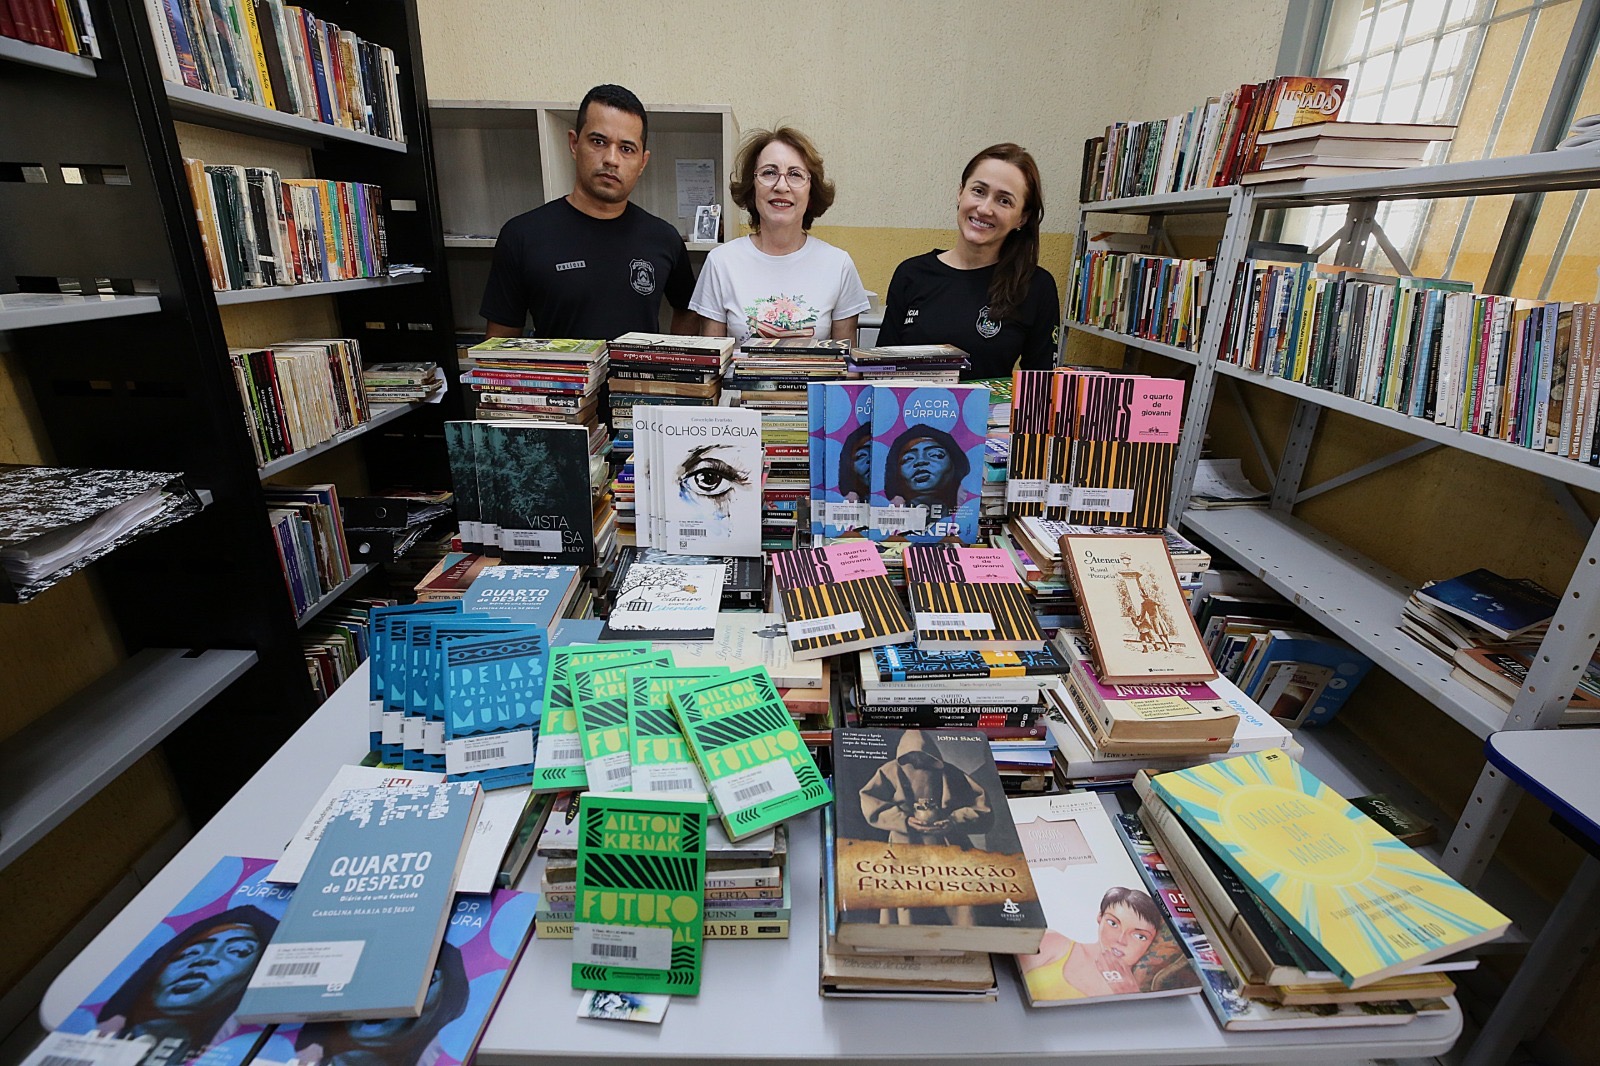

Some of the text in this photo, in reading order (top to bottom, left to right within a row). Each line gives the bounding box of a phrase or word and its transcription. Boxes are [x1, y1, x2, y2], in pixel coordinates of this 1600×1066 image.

[914, 400, 949, 408] A COR
[904, 407, 957, 418] PÚRPURA
[1141, 409, 1172, 417] giovanni
[665, 425, 707, 436] OLHOS
[526, 515, 569, 529] VISTA
[1084, 550, 1093, 558] O
[1084, 556, 1121, 564] Ateneu
[481, 589, 550, 597] QUARTO
[450, 658, 543, 687] IDEIAS
[450, 677, 543, 698] PARA ADIAR
[698, 679, 756, 705] AILTON
[1113, 685, 1191, 696] INTERIOR
[480, 695, 506, 705] FIM
[514, 691, 533, 700] DO
[701, 692, 763, 719] KRENAK
[452, 700, 544, 728] MUNDO
[707, 730, 799, 777] FUTURO
[604, 814, 680, 834] AILTON
[603, 832, 680, 852] KRENAK
[883, 850, 897, 860] A
[329, 851, 433, 877] QUARTO
[322, 873, 425, 894] de DESPEJO
[710, 891, 748, 899] CERTA
[582, 890, 698, 924] FUTURO
[720, 926, 748, 935] DE B
